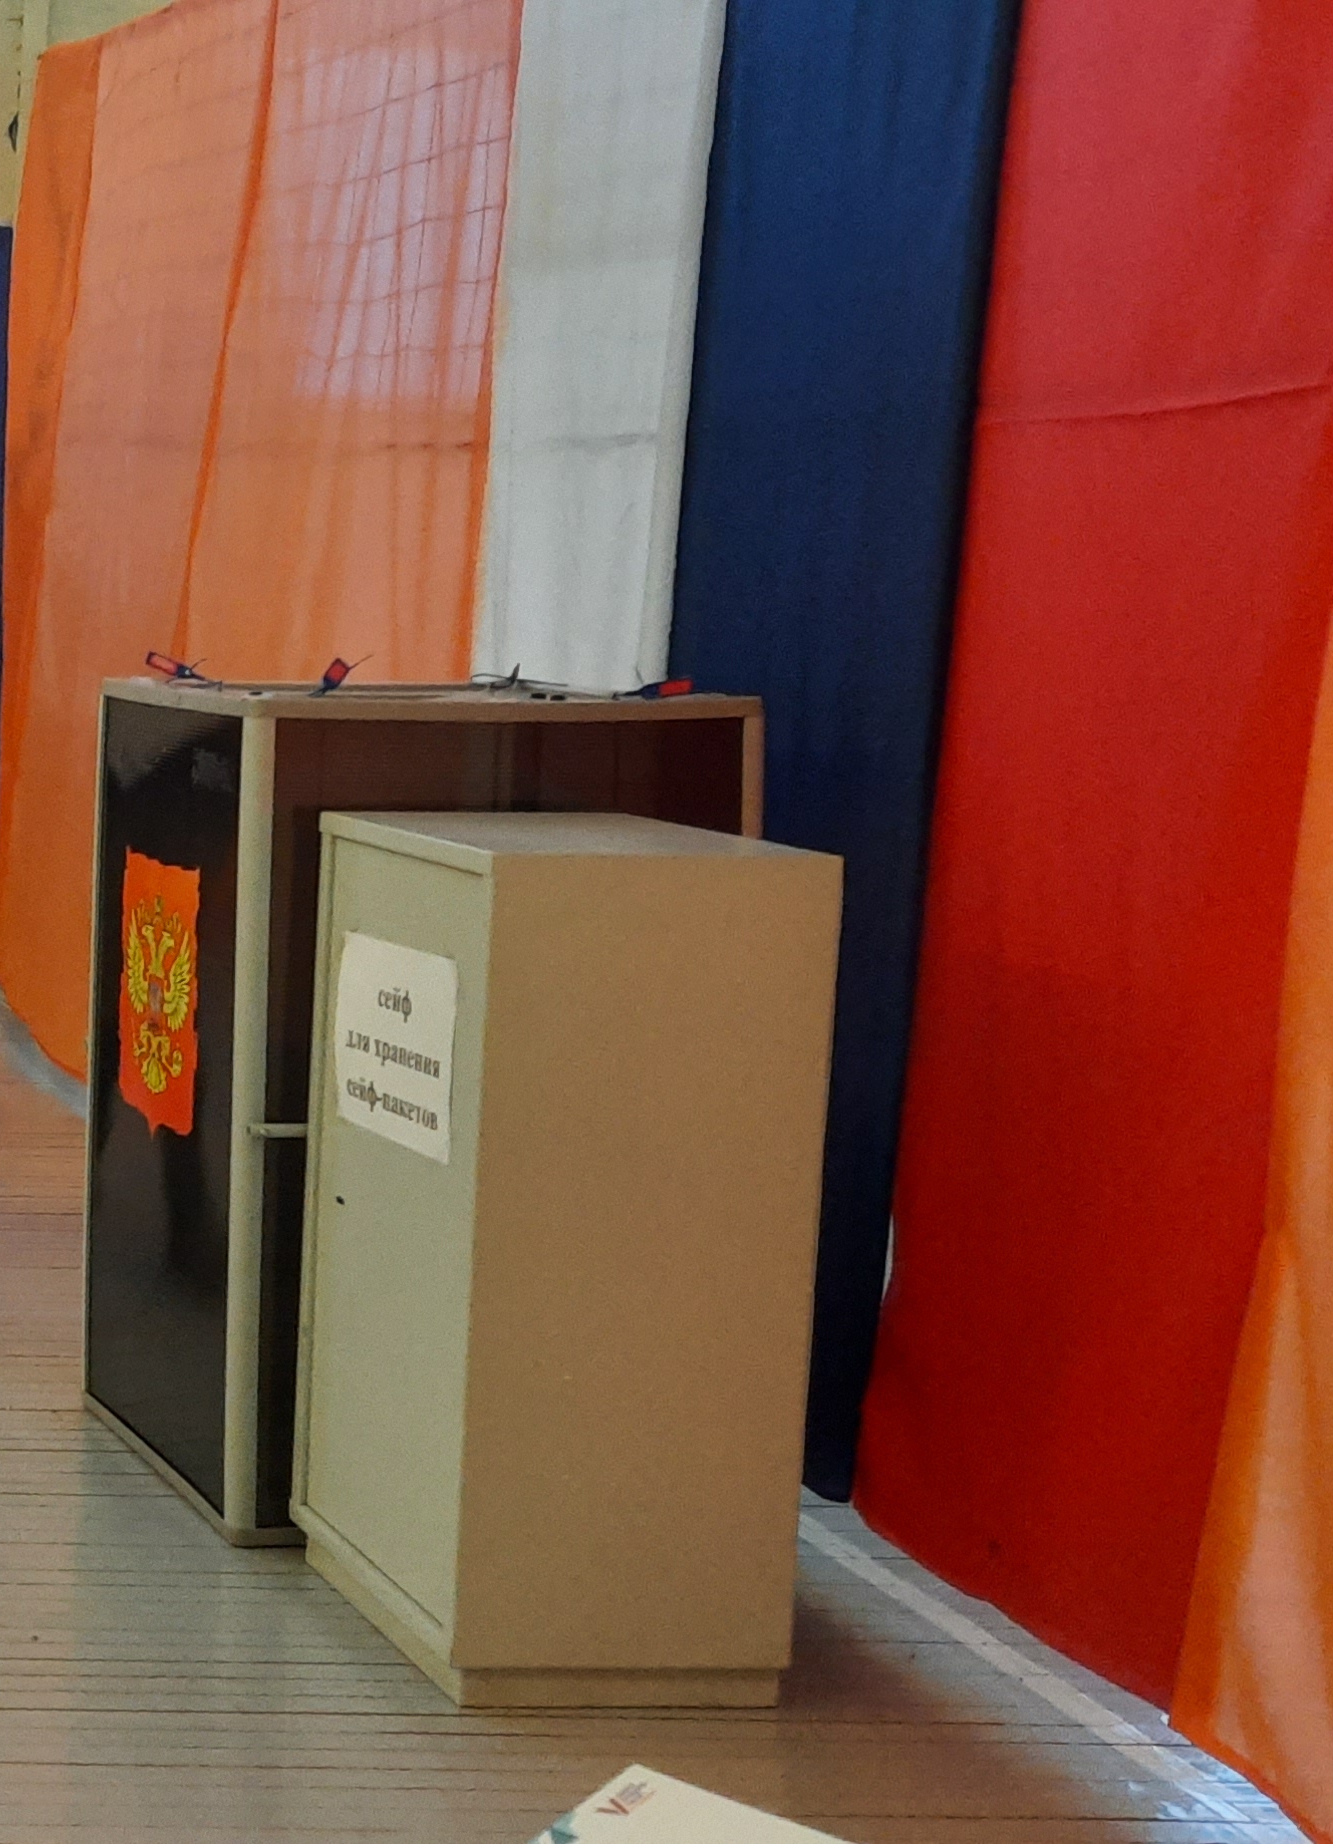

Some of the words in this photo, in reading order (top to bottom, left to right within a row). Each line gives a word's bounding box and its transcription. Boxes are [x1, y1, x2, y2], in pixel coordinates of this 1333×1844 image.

[378, 987, 413, 1023] сейф
[345, 1029, 370, 1051] для
[374, 1038, 441, 1079] хранения
[346, 1076, 439, 1131] сейф-пакетов
